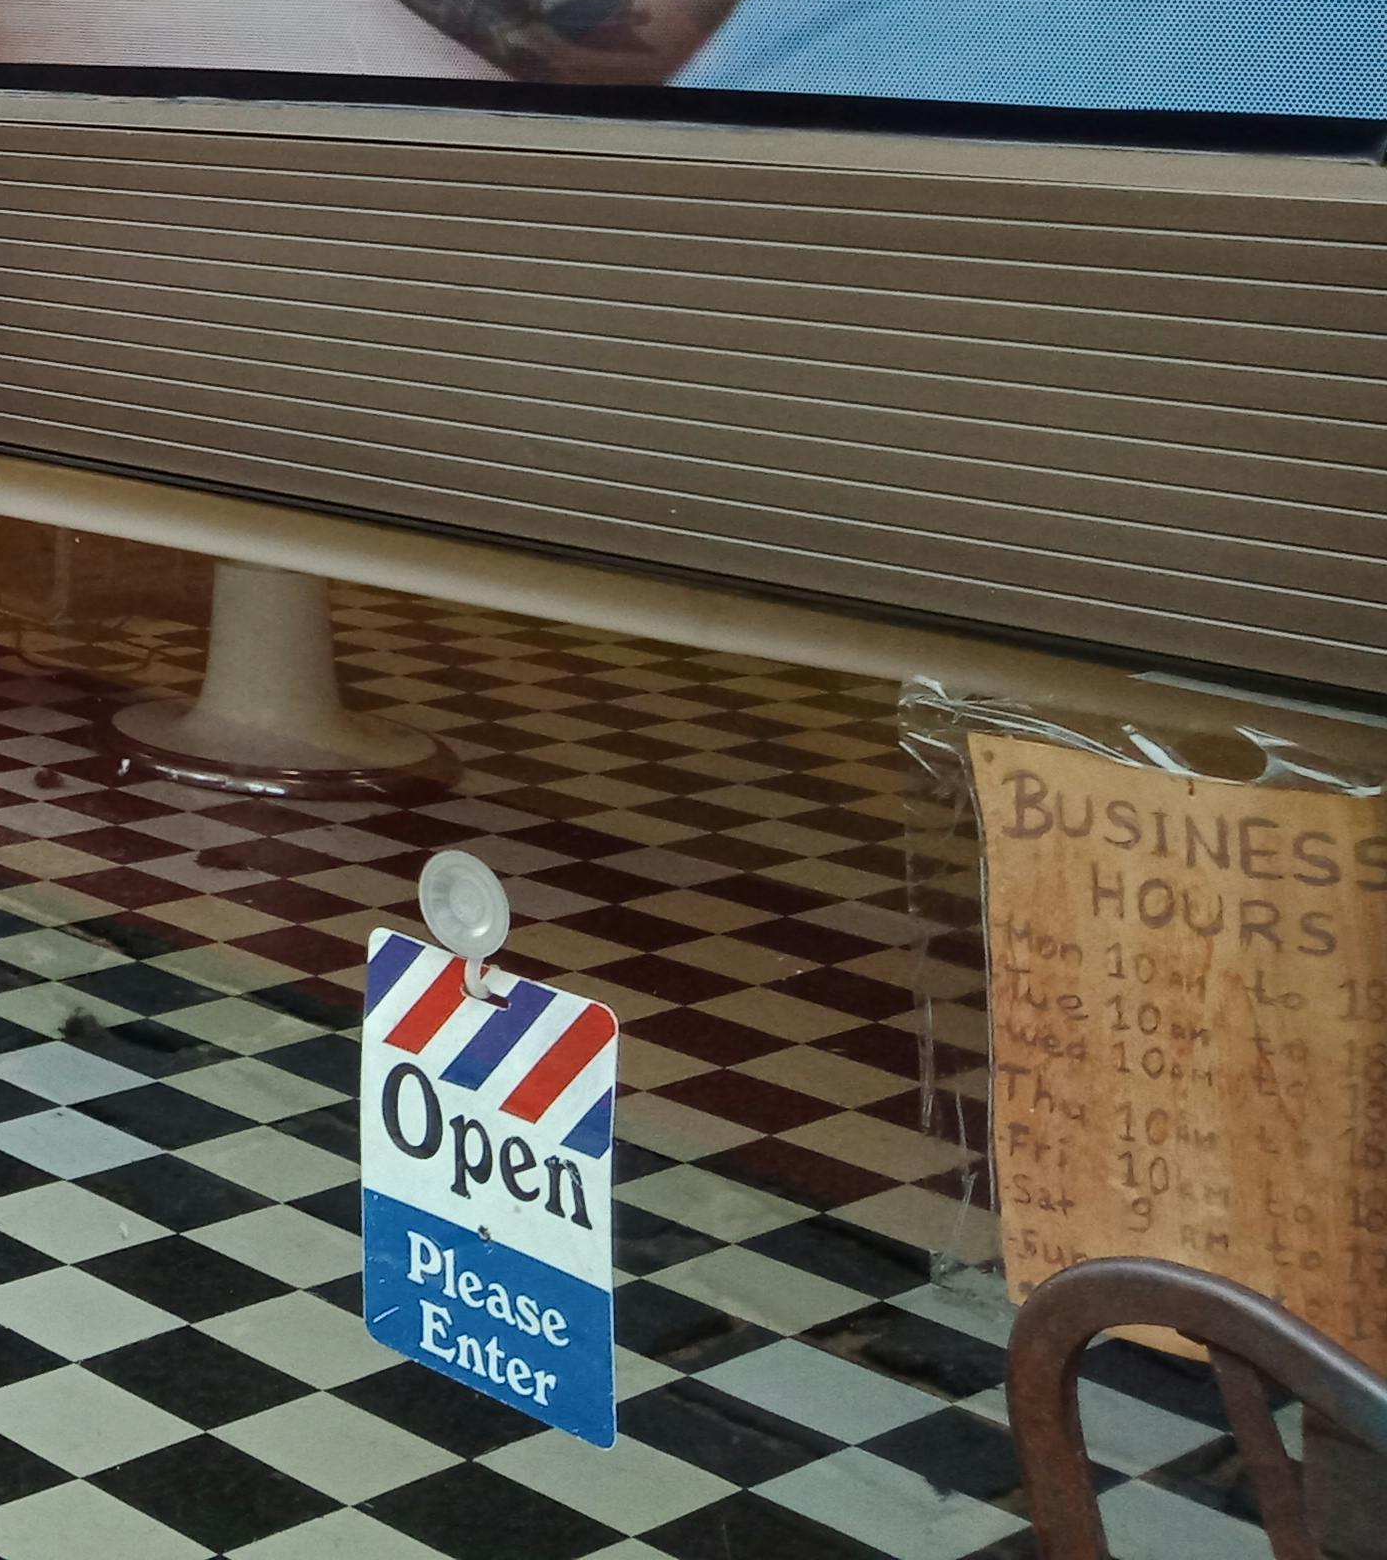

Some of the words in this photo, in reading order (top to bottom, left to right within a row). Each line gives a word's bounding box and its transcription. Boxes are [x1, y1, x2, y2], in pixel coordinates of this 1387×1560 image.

[1091, 862, 1338, 956] HOURS
[1245, 969, 1305, 1011] to
[381, 1061, 594, 1230] Open
[1011, 1175, 1075, 1215] Sat
[407, 1230, 571, 1348] Please
[418, 1298, 558, 1408] Enter
